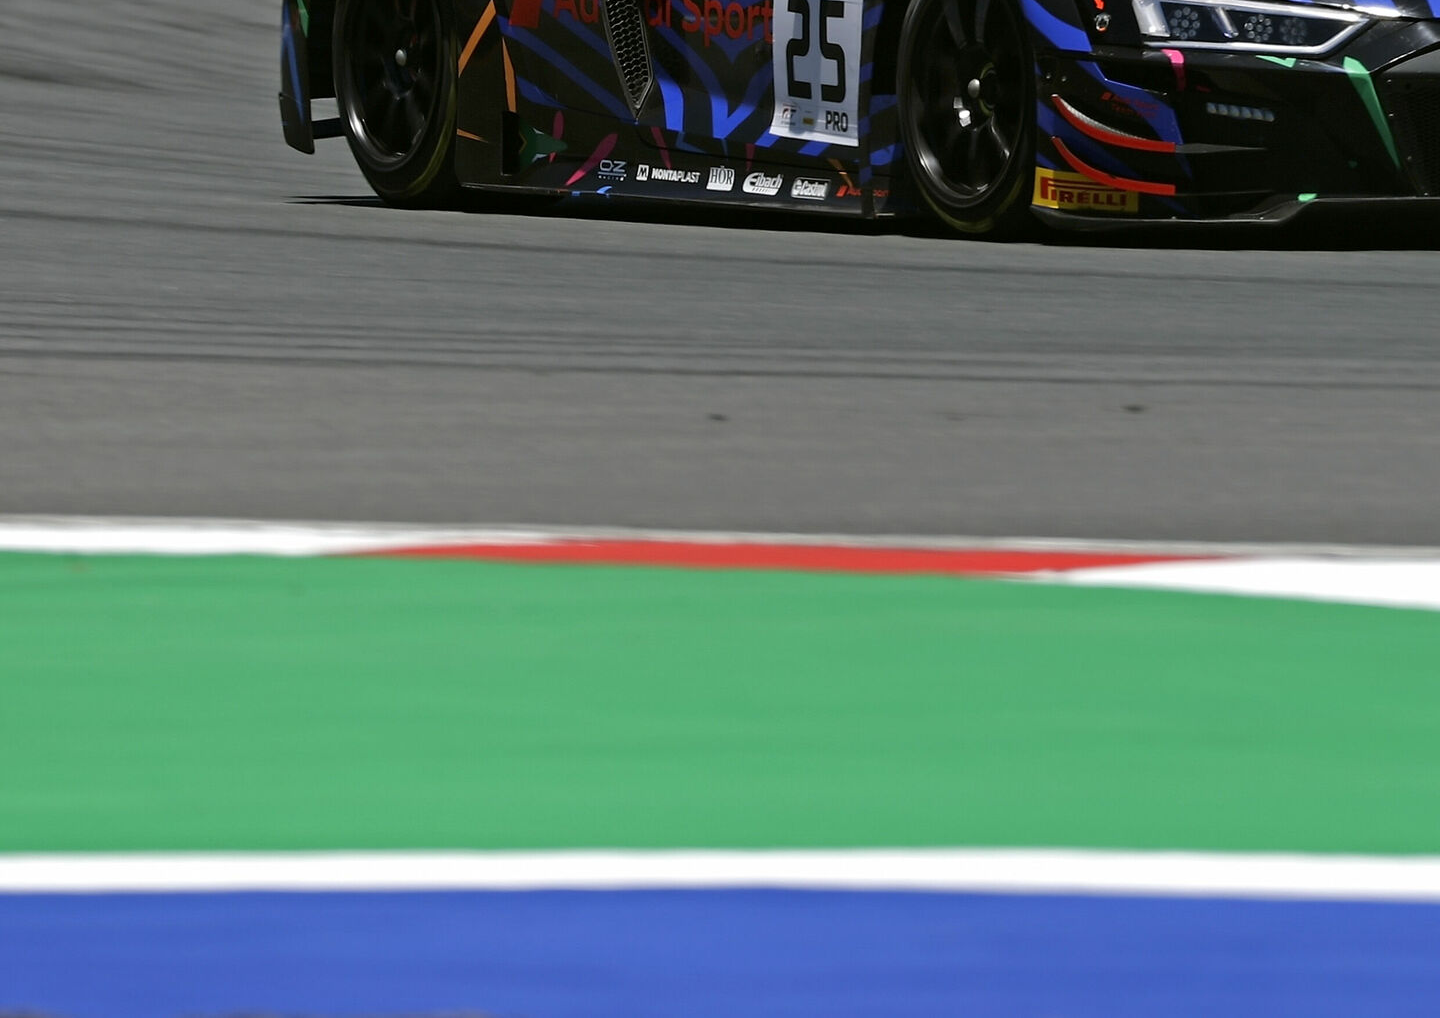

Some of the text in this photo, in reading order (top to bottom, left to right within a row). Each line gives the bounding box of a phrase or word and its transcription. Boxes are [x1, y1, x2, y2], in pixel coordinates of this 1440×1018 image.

[825, 110, 849, 133] PRO
[600, 159, 627, 173] OZ
[651, 167, 701, 183] MONTAPLAST
[743, 172, 783, 190] Eibach
[1040, 176, 1128, 207] PIRELLI
